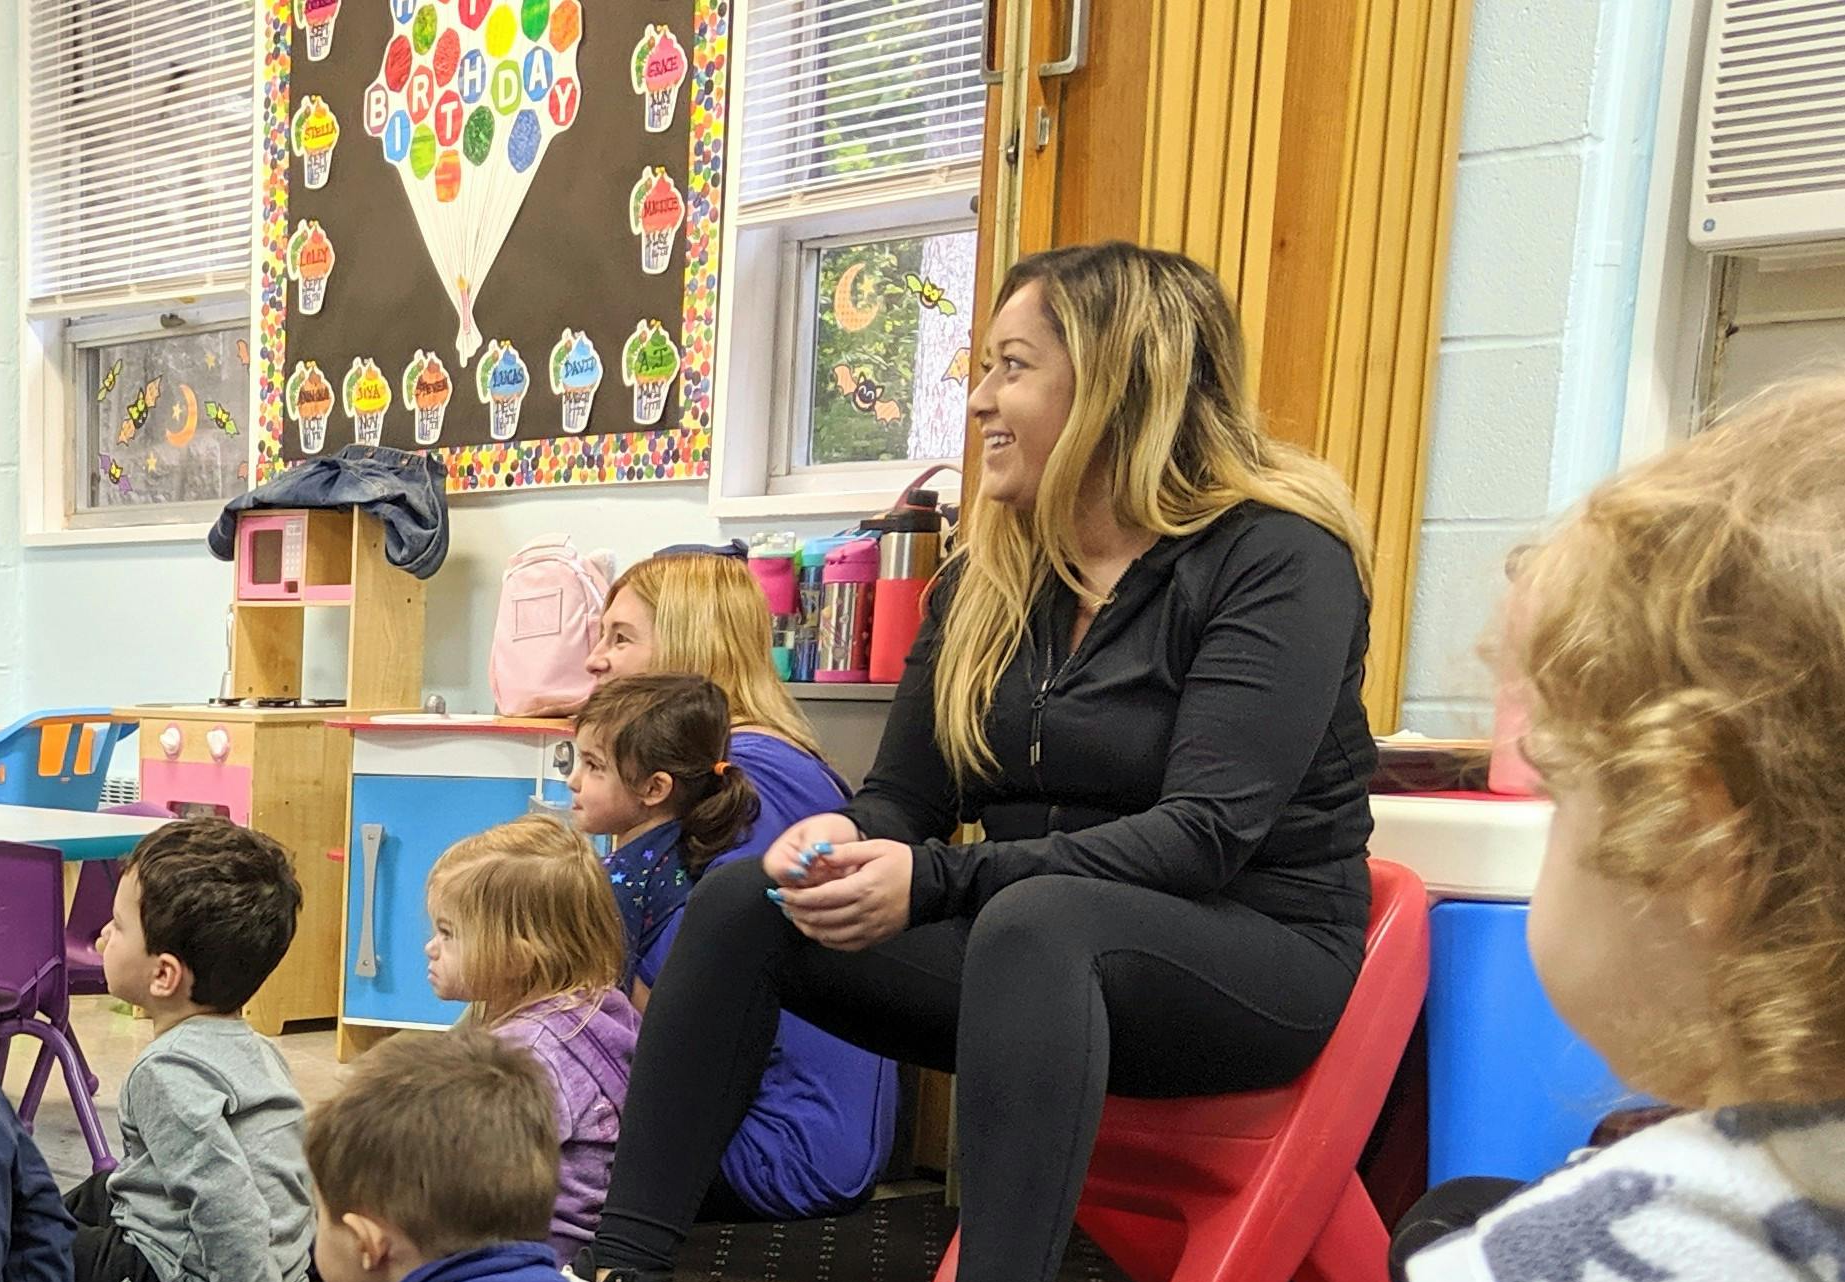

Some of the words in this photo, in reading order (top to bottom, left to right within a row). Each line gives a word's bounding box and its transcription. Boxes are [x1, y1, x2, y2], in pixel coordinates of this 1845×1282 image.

[368, 50, 573, 151] BIRTHDAY
[304, 120, 337, 140] STELLA
[492, 367, 524, 388] LUCAS
[564, 357, 596, 378] DAVID
